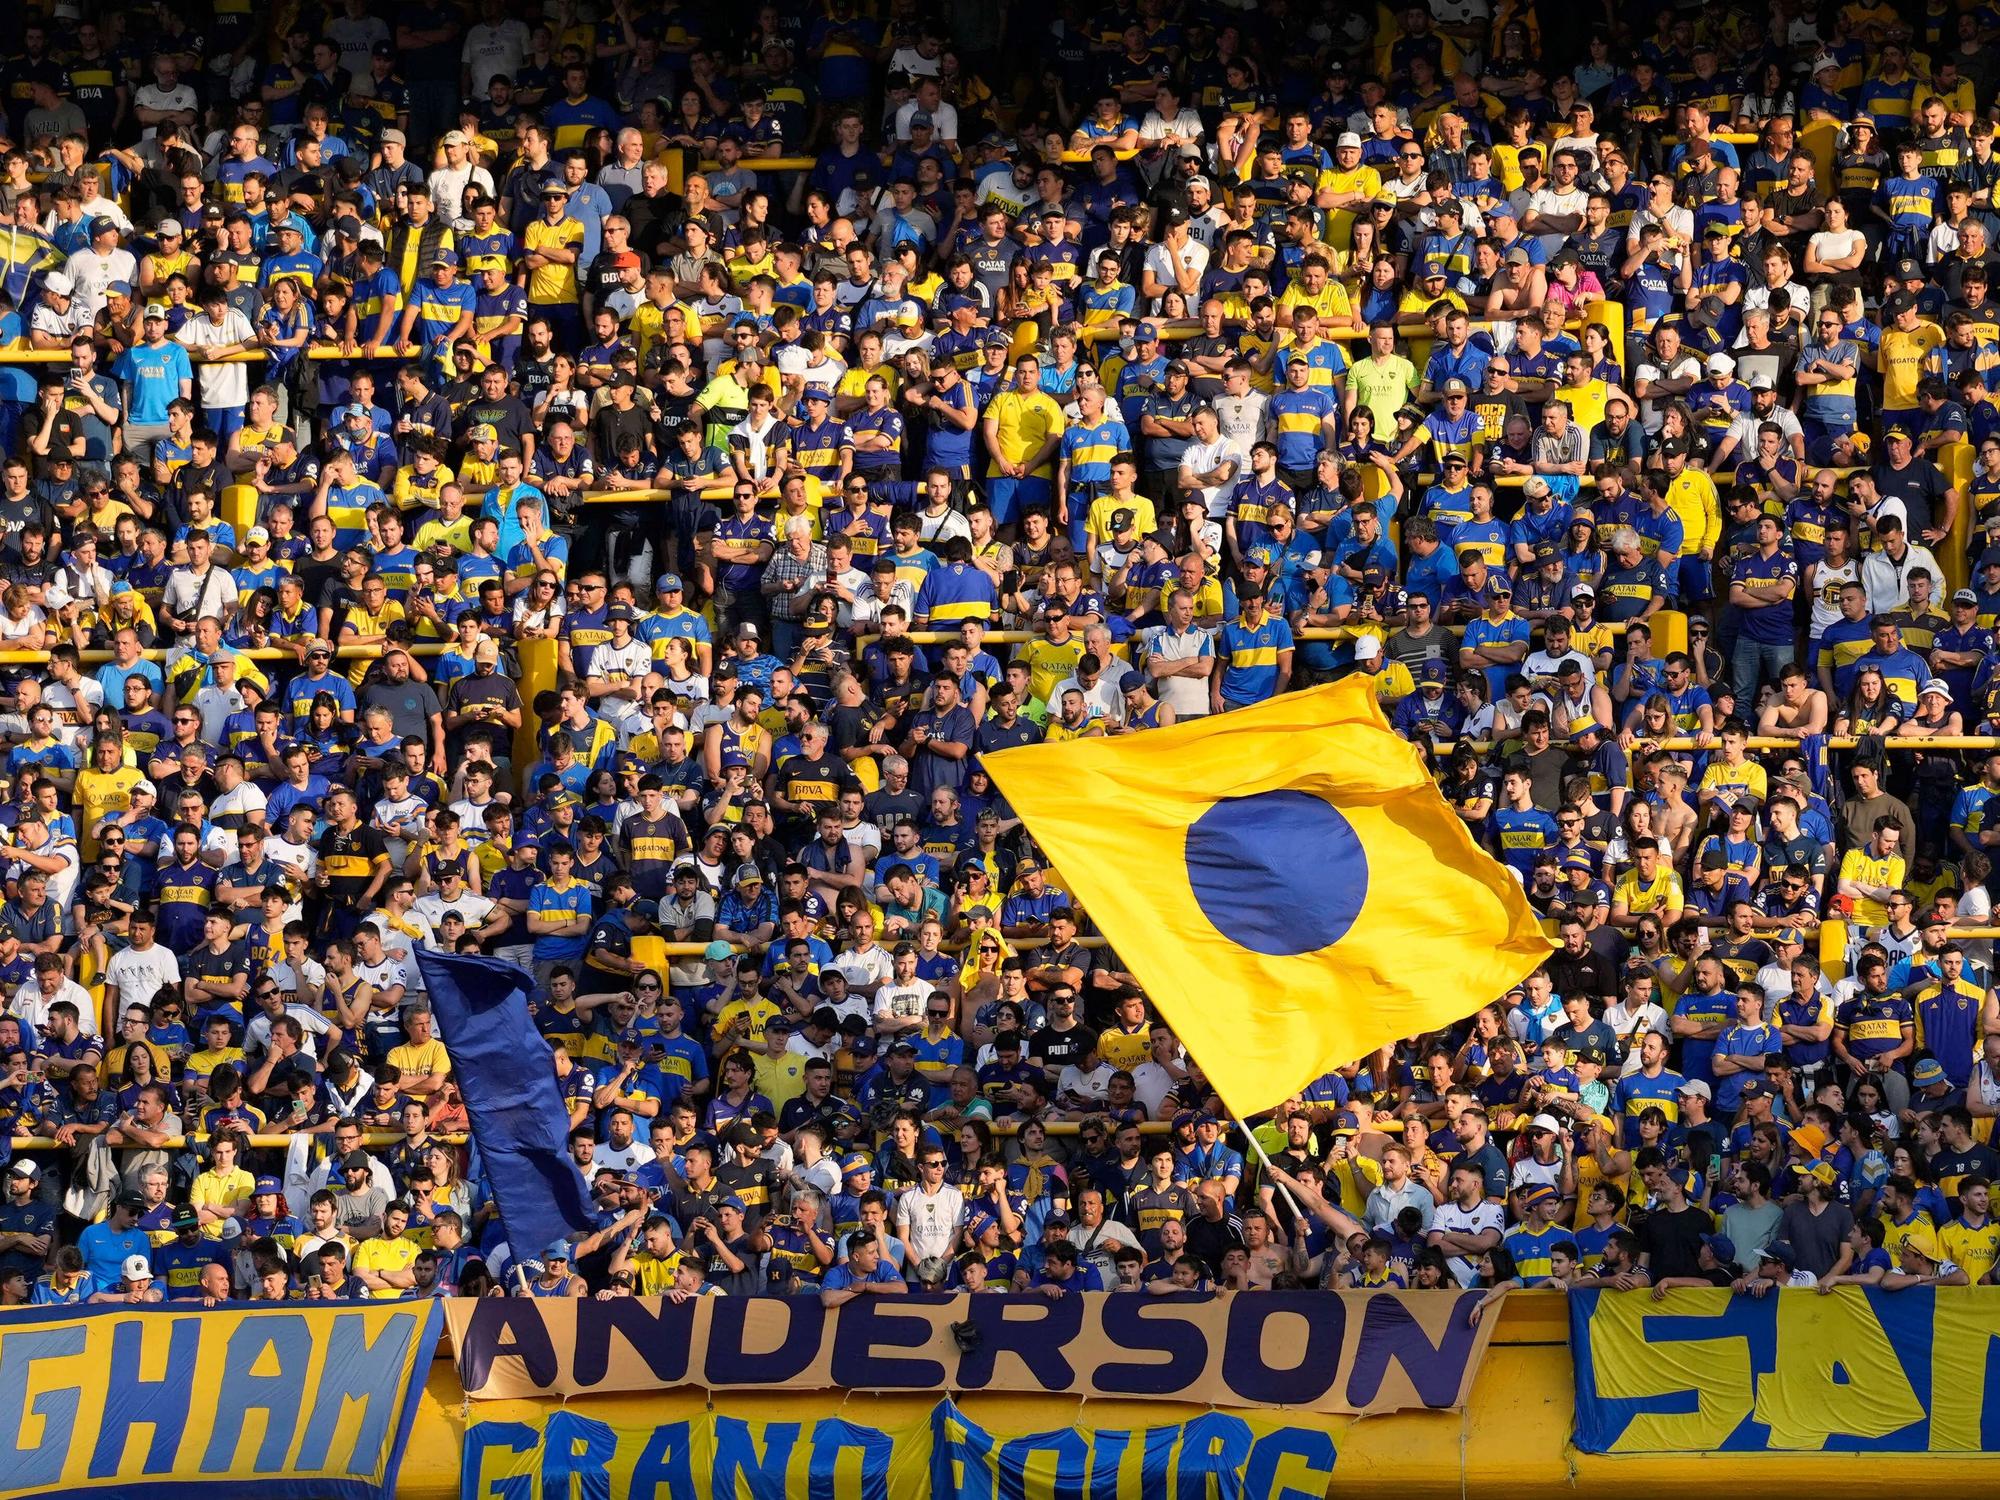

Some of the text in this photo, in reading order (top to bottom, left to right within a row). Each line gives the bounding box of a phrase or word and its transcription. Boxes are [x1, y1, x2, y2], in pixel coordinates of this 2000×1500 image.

[1058, 49, 1084, 57] QATAR
[1578, 254, 1607, 262] QATAR
[978, 260, 1005, 269] QATAR
[1640, 278, 1668, 289] QATAR
[429, 307, 455, 316] QATAR
[528, 374, 550, 386] BBVA
[1363, 384, 1393, 394] QATAR
[1224, 423, 1251, 432] QATAR
[574, 630, 608, 641] QATAR
[1041, 662, 1073, 673] QATAR
[57, 712, 78, 723] BVA
[793, 785, 824, 796] BBVA
[88, 794, 121, 804] QATAR
[1504, 834, 1531, 843] QATAR
[633, 843, 670, 854] MEGATONE
[166, 888, 194, 897] QATAR
[1859, 1022, 1888, 1032] QATAR
[1118, 1054, 1147, 1065] QATAR
[1635, 1102, 1664, 1111] QATAR
[1955, 1163, 1965, 1172] 18
[1141, 1216, 1170, 1224] MEGATO
[916, 1225, 944, 1234] QATAR
[1965, 1249, 1993, 1258] QATAR
[771, 1271, 780, 1281] H
[459, 1290, 1489, 1408] ANDERSON
[0, 1314, 418, 1490] GHAM
